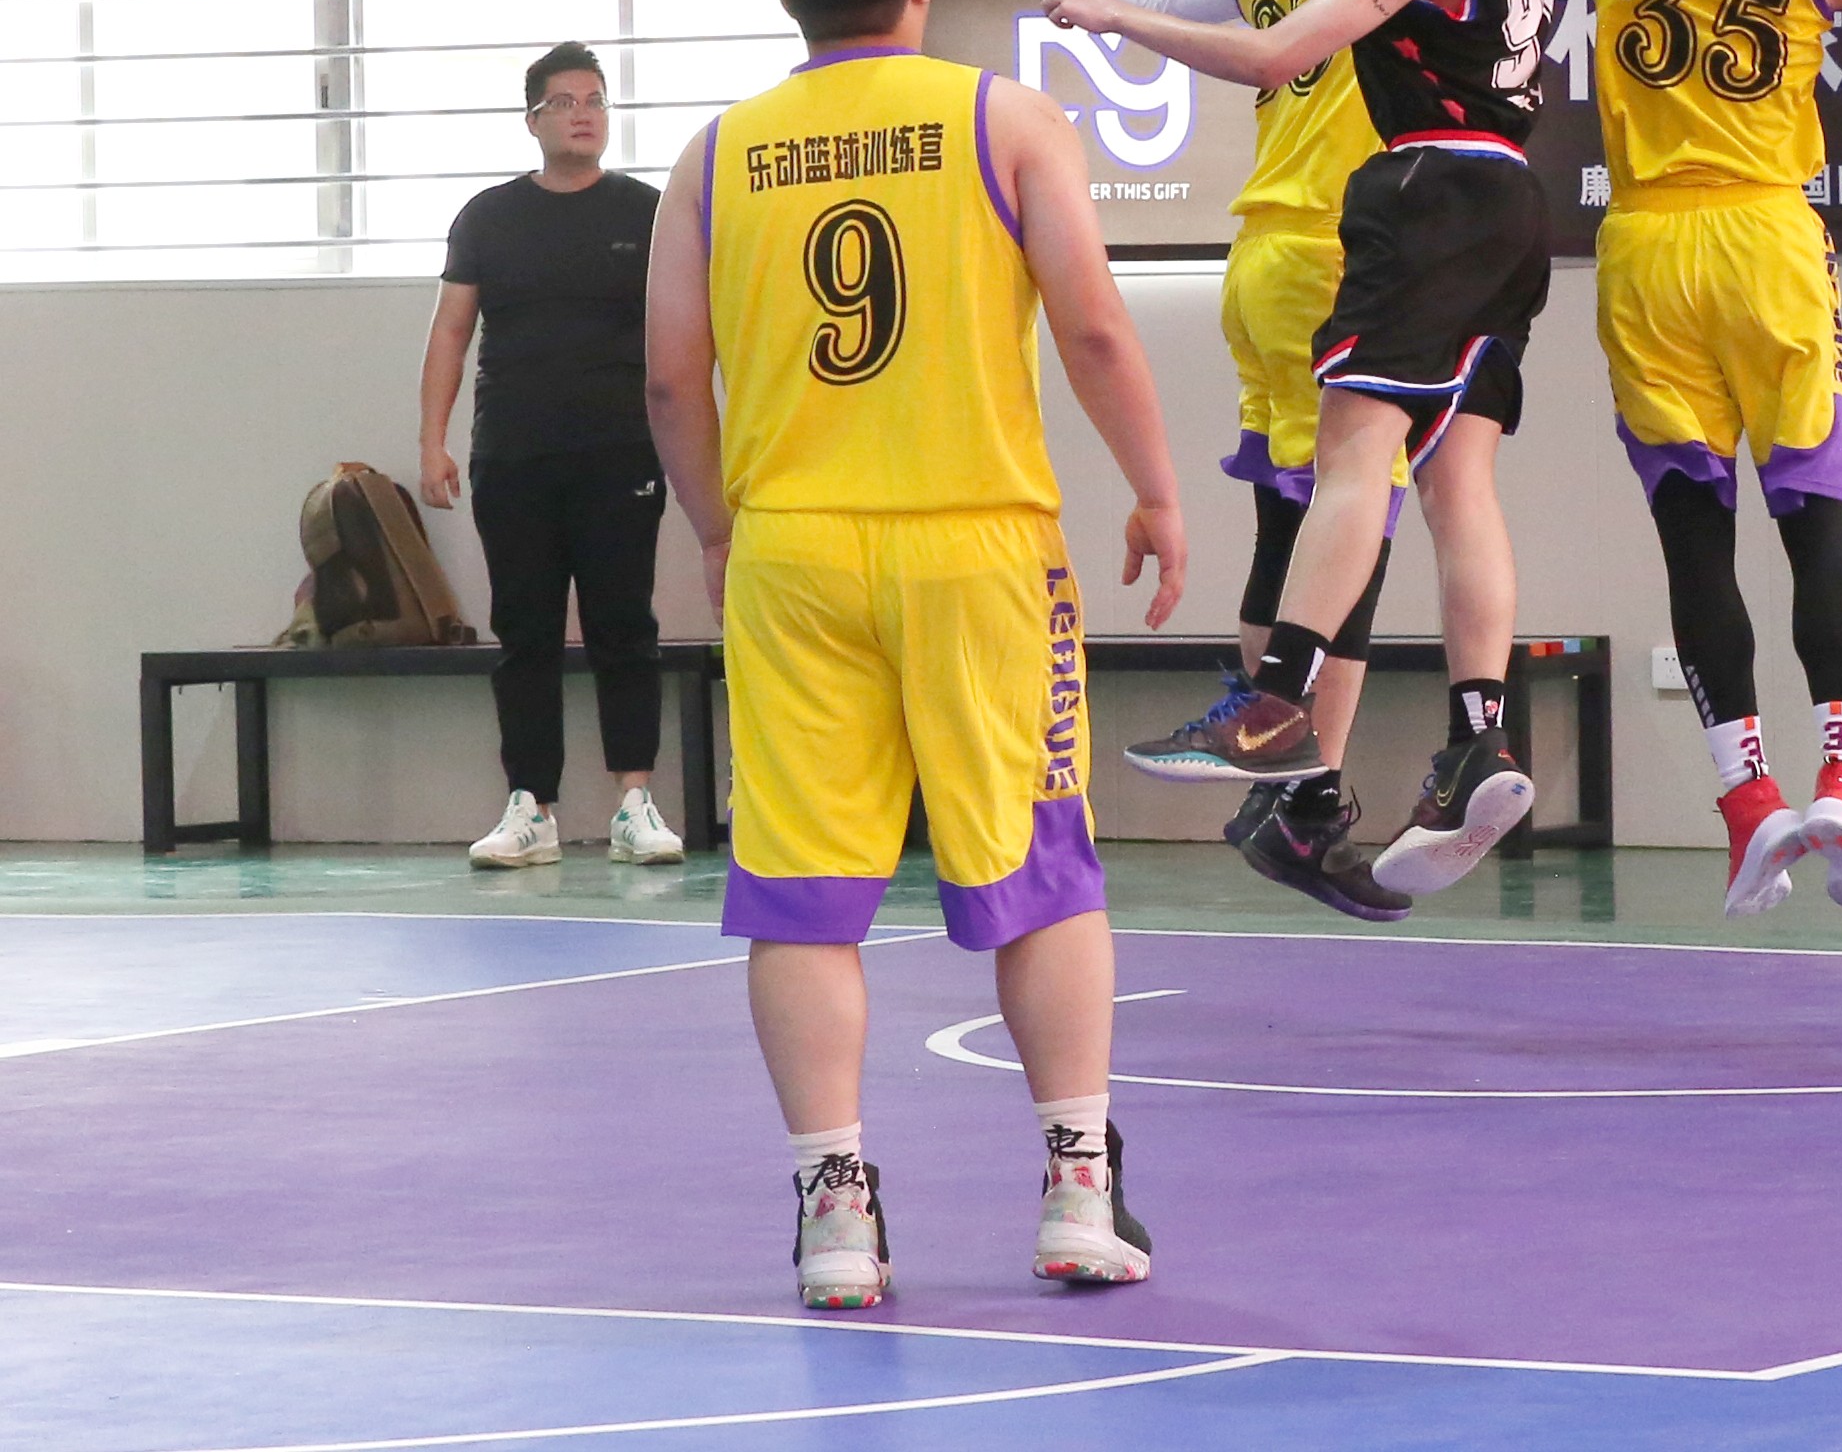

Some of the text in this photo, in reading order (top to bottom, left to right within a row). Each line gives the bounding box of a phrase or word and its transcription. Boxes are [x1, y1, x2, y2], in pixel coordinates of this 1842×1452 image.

[747, 122, 944, 194] 乐动篮球训练营
[1114, 182, 1151, 200] THIS
[1154, 182, 1190, 200] GIFT
[803, 198, 907, 386] 9
[1044, 566, 1081, 791] LEAGUE
